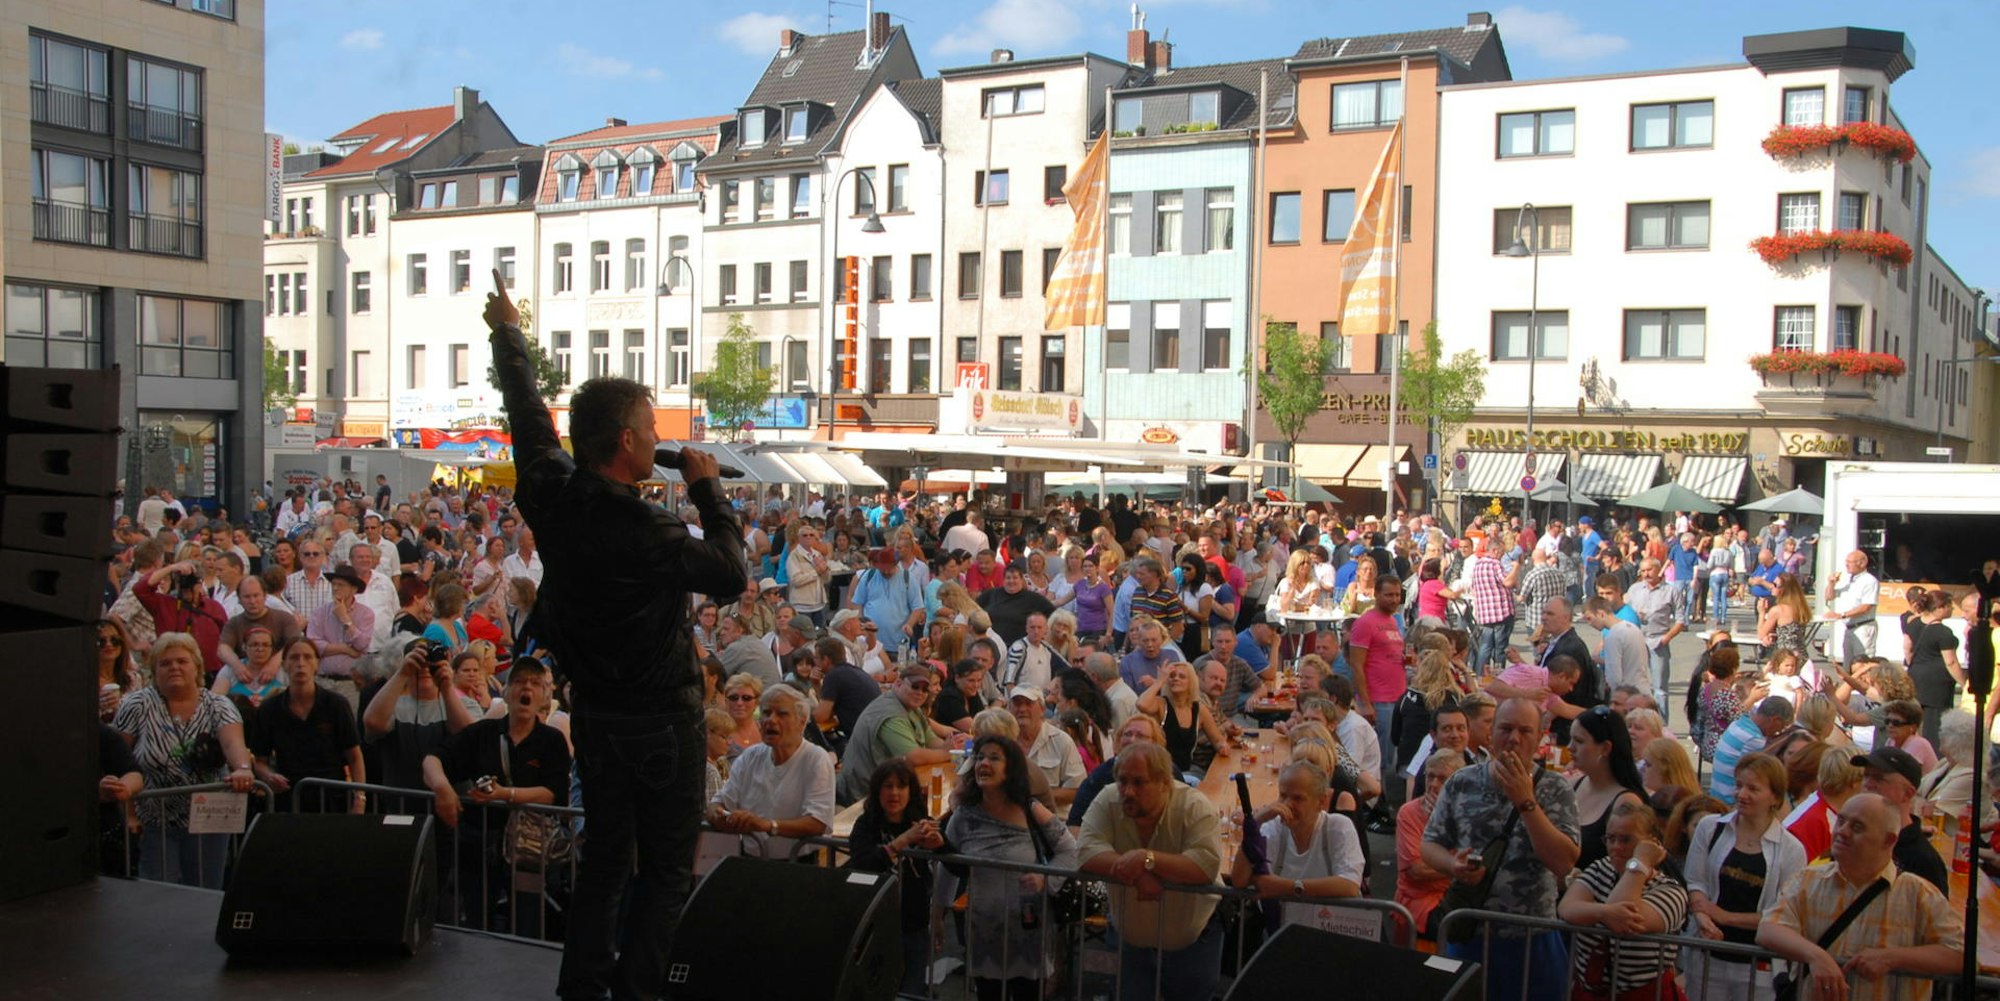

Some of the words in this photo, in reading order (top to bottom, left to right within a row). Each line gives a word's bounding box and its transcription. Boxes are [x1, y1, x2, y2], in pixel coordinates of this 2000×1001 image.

[1466, 429, 1525, 447] HAUS
[1530, 430, 1655, 449] SCHOLZEN
[1659, 432, 1693, 449] seit
[1698, 432, 1746, 450] 1907
